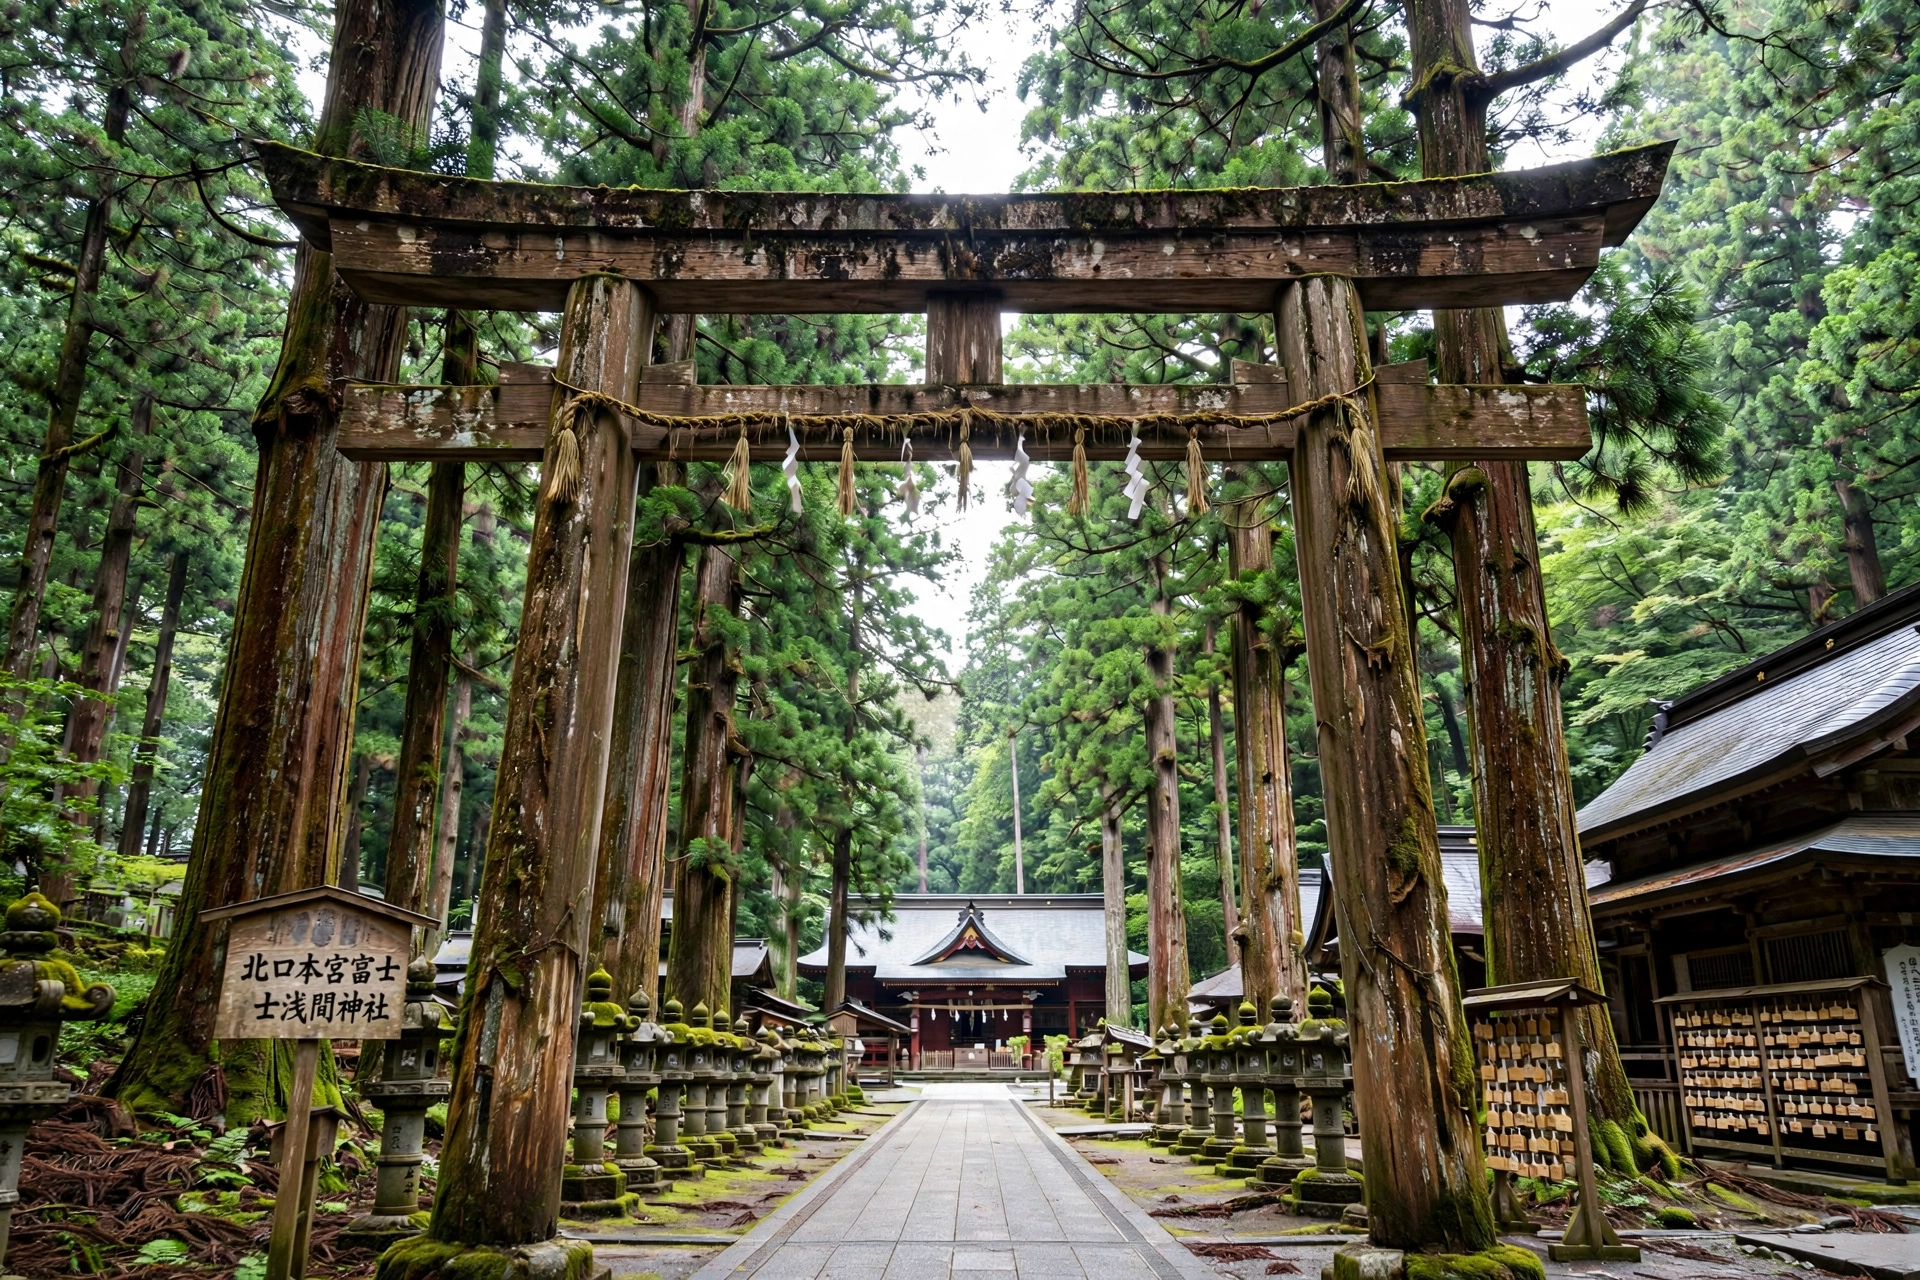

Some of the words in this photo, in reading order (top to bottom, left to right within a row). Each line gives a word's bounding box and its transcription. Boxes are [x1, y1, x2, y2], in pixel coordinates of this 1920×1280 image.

[241, 953, 400, 984] 北口本宮富士
[253, 990, 390, 1024] 士浅間神社
